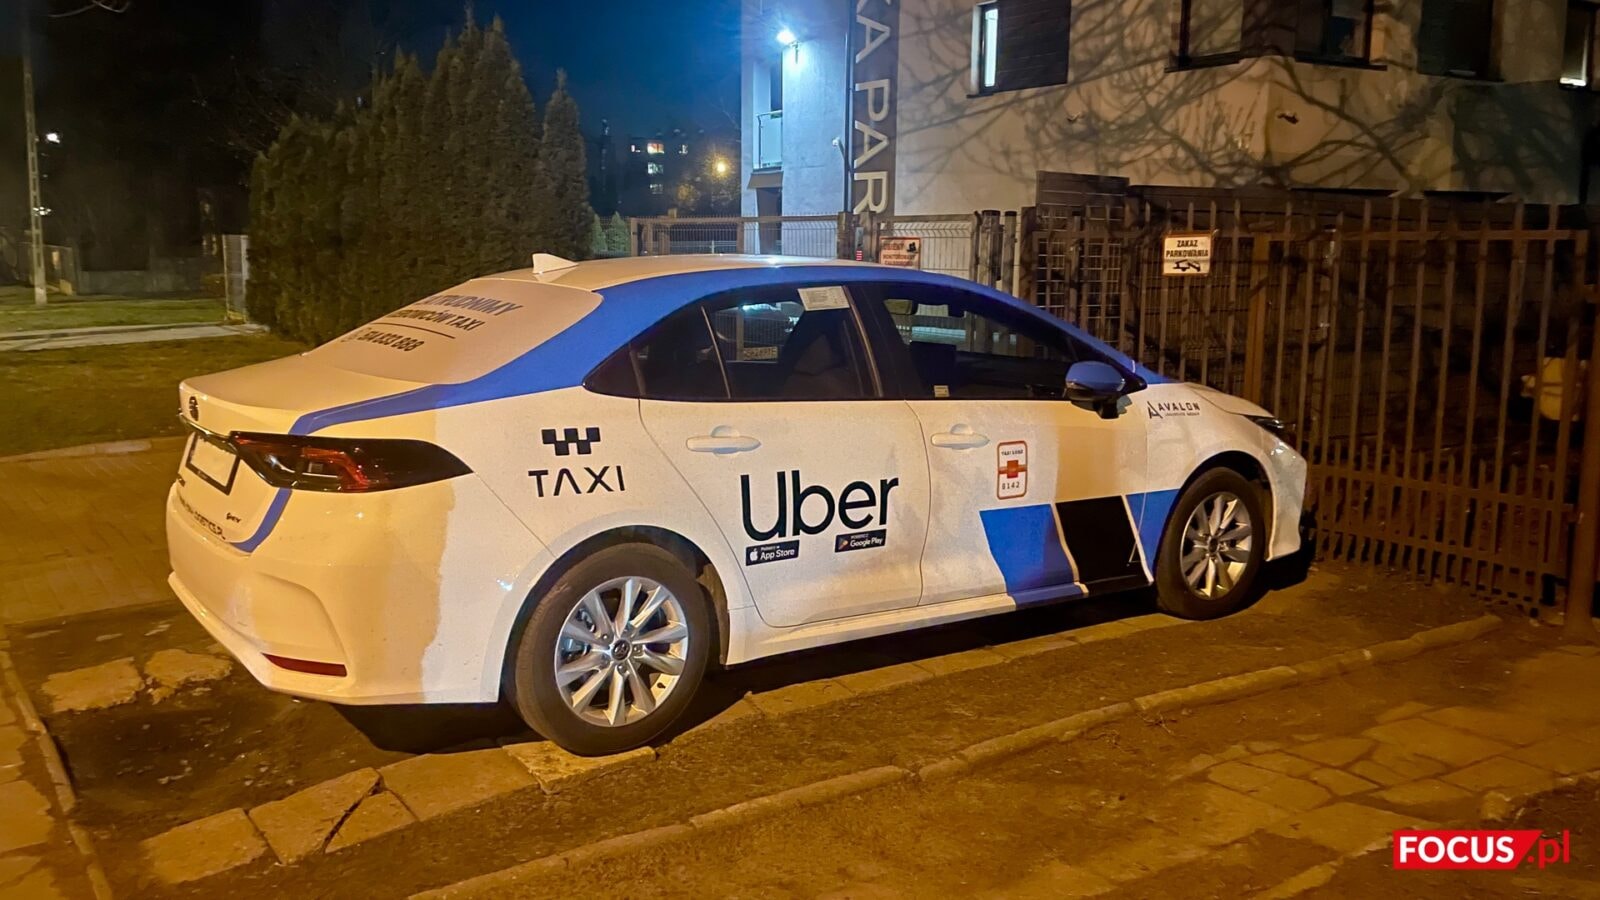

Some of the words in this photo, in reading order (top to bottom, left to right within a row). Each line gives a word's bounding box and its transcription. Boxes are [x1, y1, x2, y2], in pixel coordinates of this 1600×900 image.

[1177, 240, 1198, 248] ZAKAZ
[1165, 249, 1209, 257] PARKOWANIA
[446, 315, 486, 331] TAXI
[1158, 402, 1201, 411] AVALON
[527, 465, 626, 497] TAXI
[740, 469, 899, 541] Uber
[849, 538, 871, 547] Google
[871, 537, 884, 545] Play
[760, 550, 775, 561] App
[776, 548, 795, 557] Store
